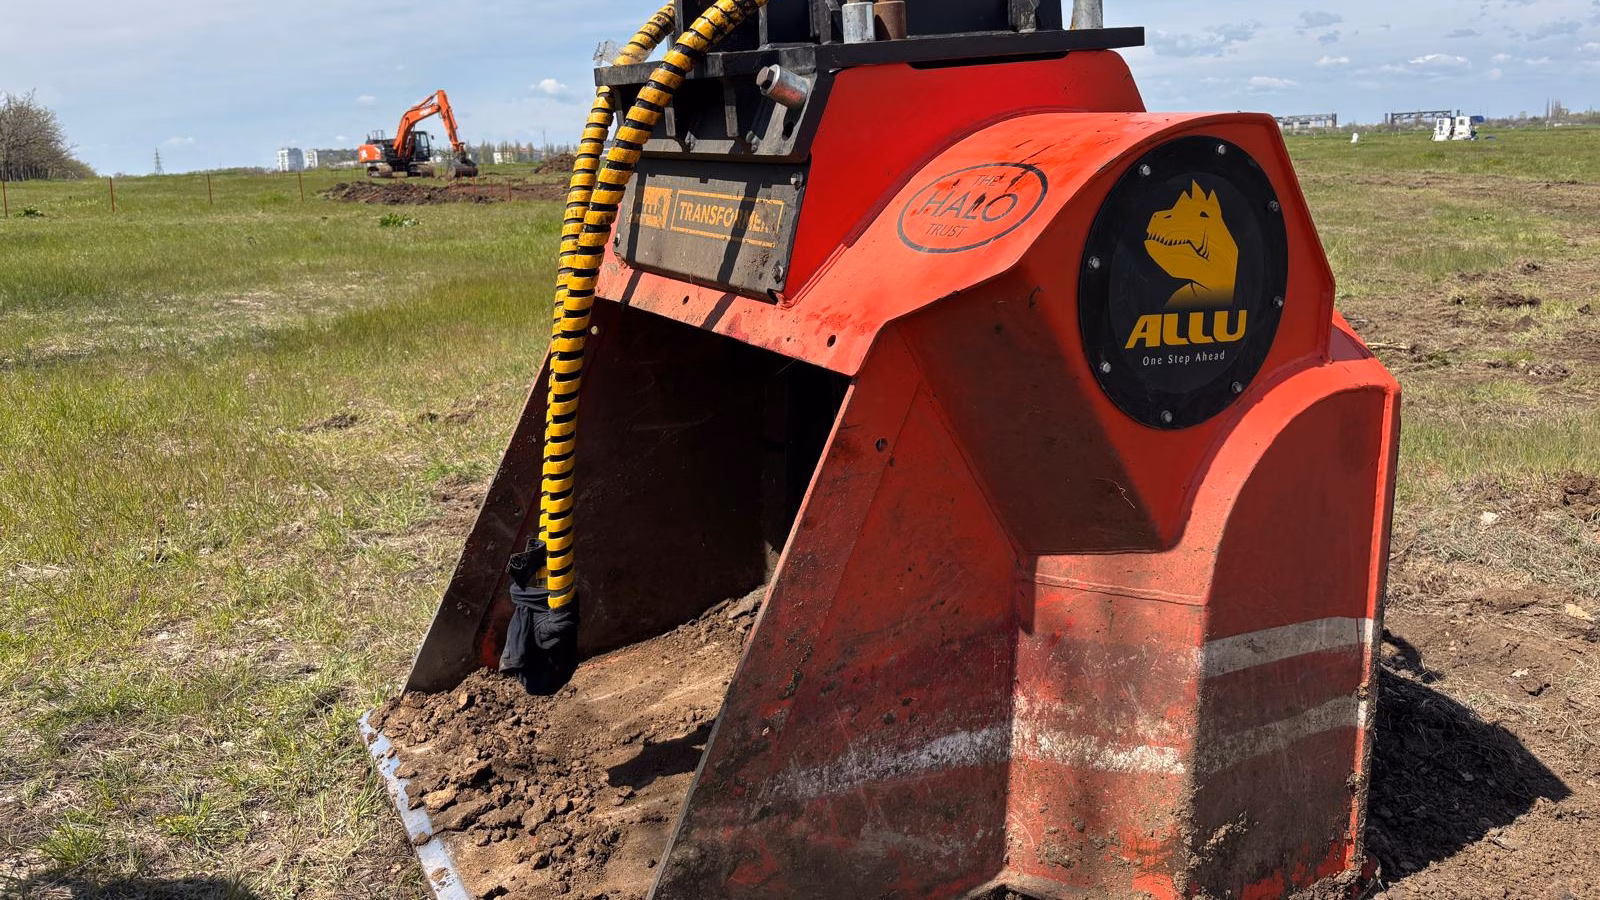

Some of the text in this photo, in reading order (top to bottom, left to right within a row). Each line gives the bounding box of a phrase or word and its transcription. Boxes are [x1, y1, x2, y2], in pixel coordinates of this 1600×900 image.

[972, 174, 1001, 187] THE
[916, 190, 1019, 222] HALO
[925, 223, 969, 238] TRUST
[1124, 309, 1248, 349] ALLU
[1142, 349, 1226, 367] One Step Ahead
